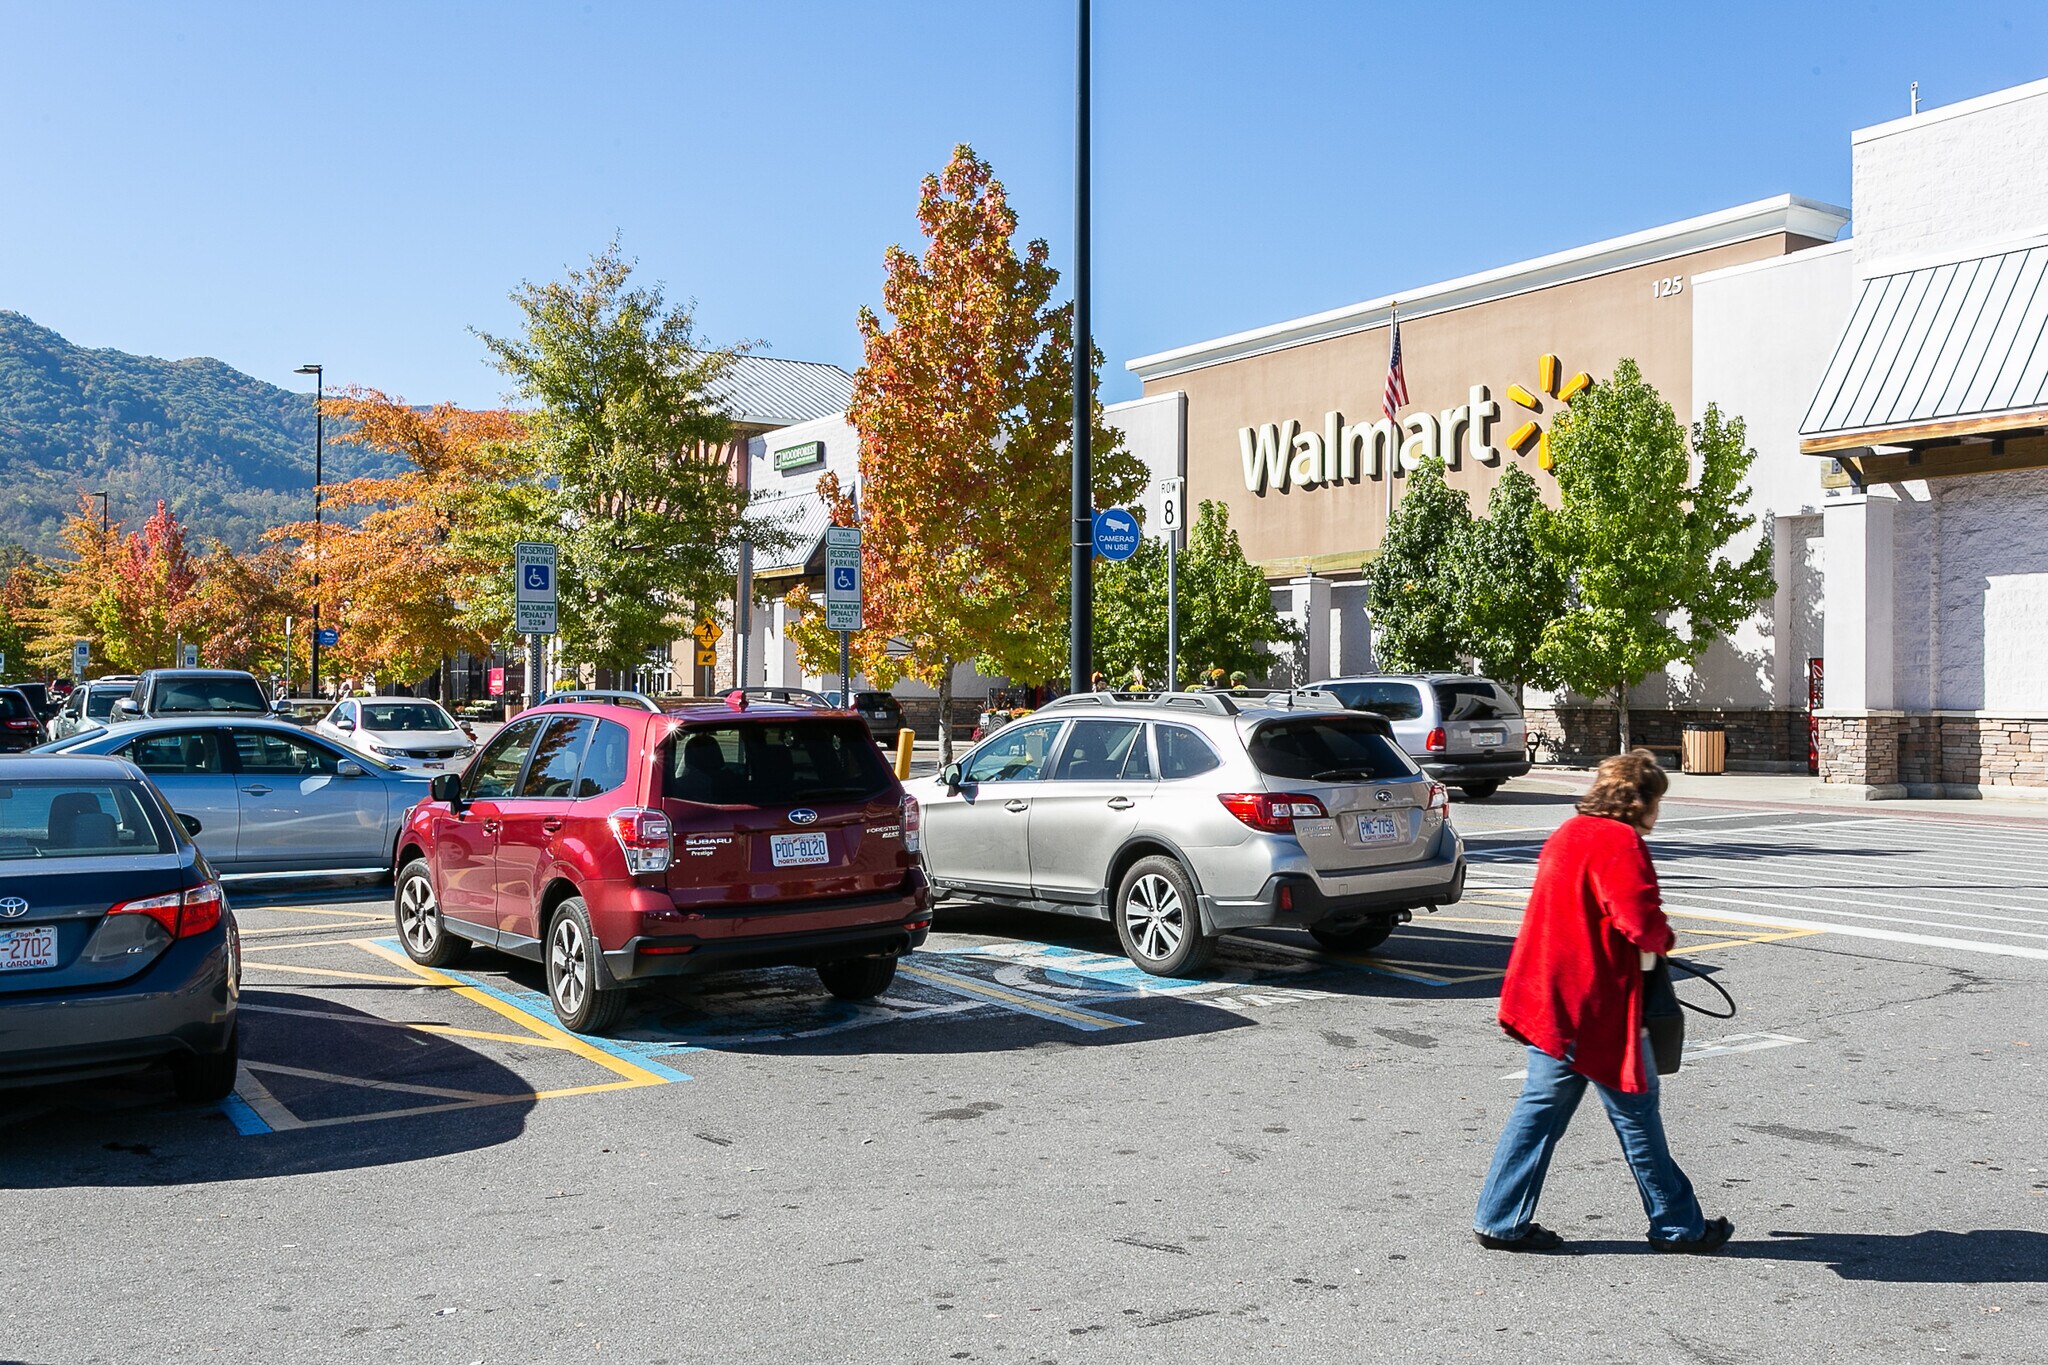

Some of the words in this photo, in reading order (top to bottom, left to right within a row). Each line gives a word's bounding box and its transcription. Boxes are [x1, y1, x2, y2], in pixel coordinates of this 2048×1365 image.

[1652, 275, 1684, 299] 125
[1238, 384, 1497, 493] Walmart
[1161, 482, 1177, 494] ROW
[1164, 500, 1174, 525] 8
[1098, 535, 1135, 543] CAMERAS
[520, 546, 553, 555] RESERVED
[830, 550, 859, 559] RESERVED
[520, 556, 553, 565] PARKING
[830, 559, 859, 567] PARKING
[6, 959, 48, 968] CAROLINA
